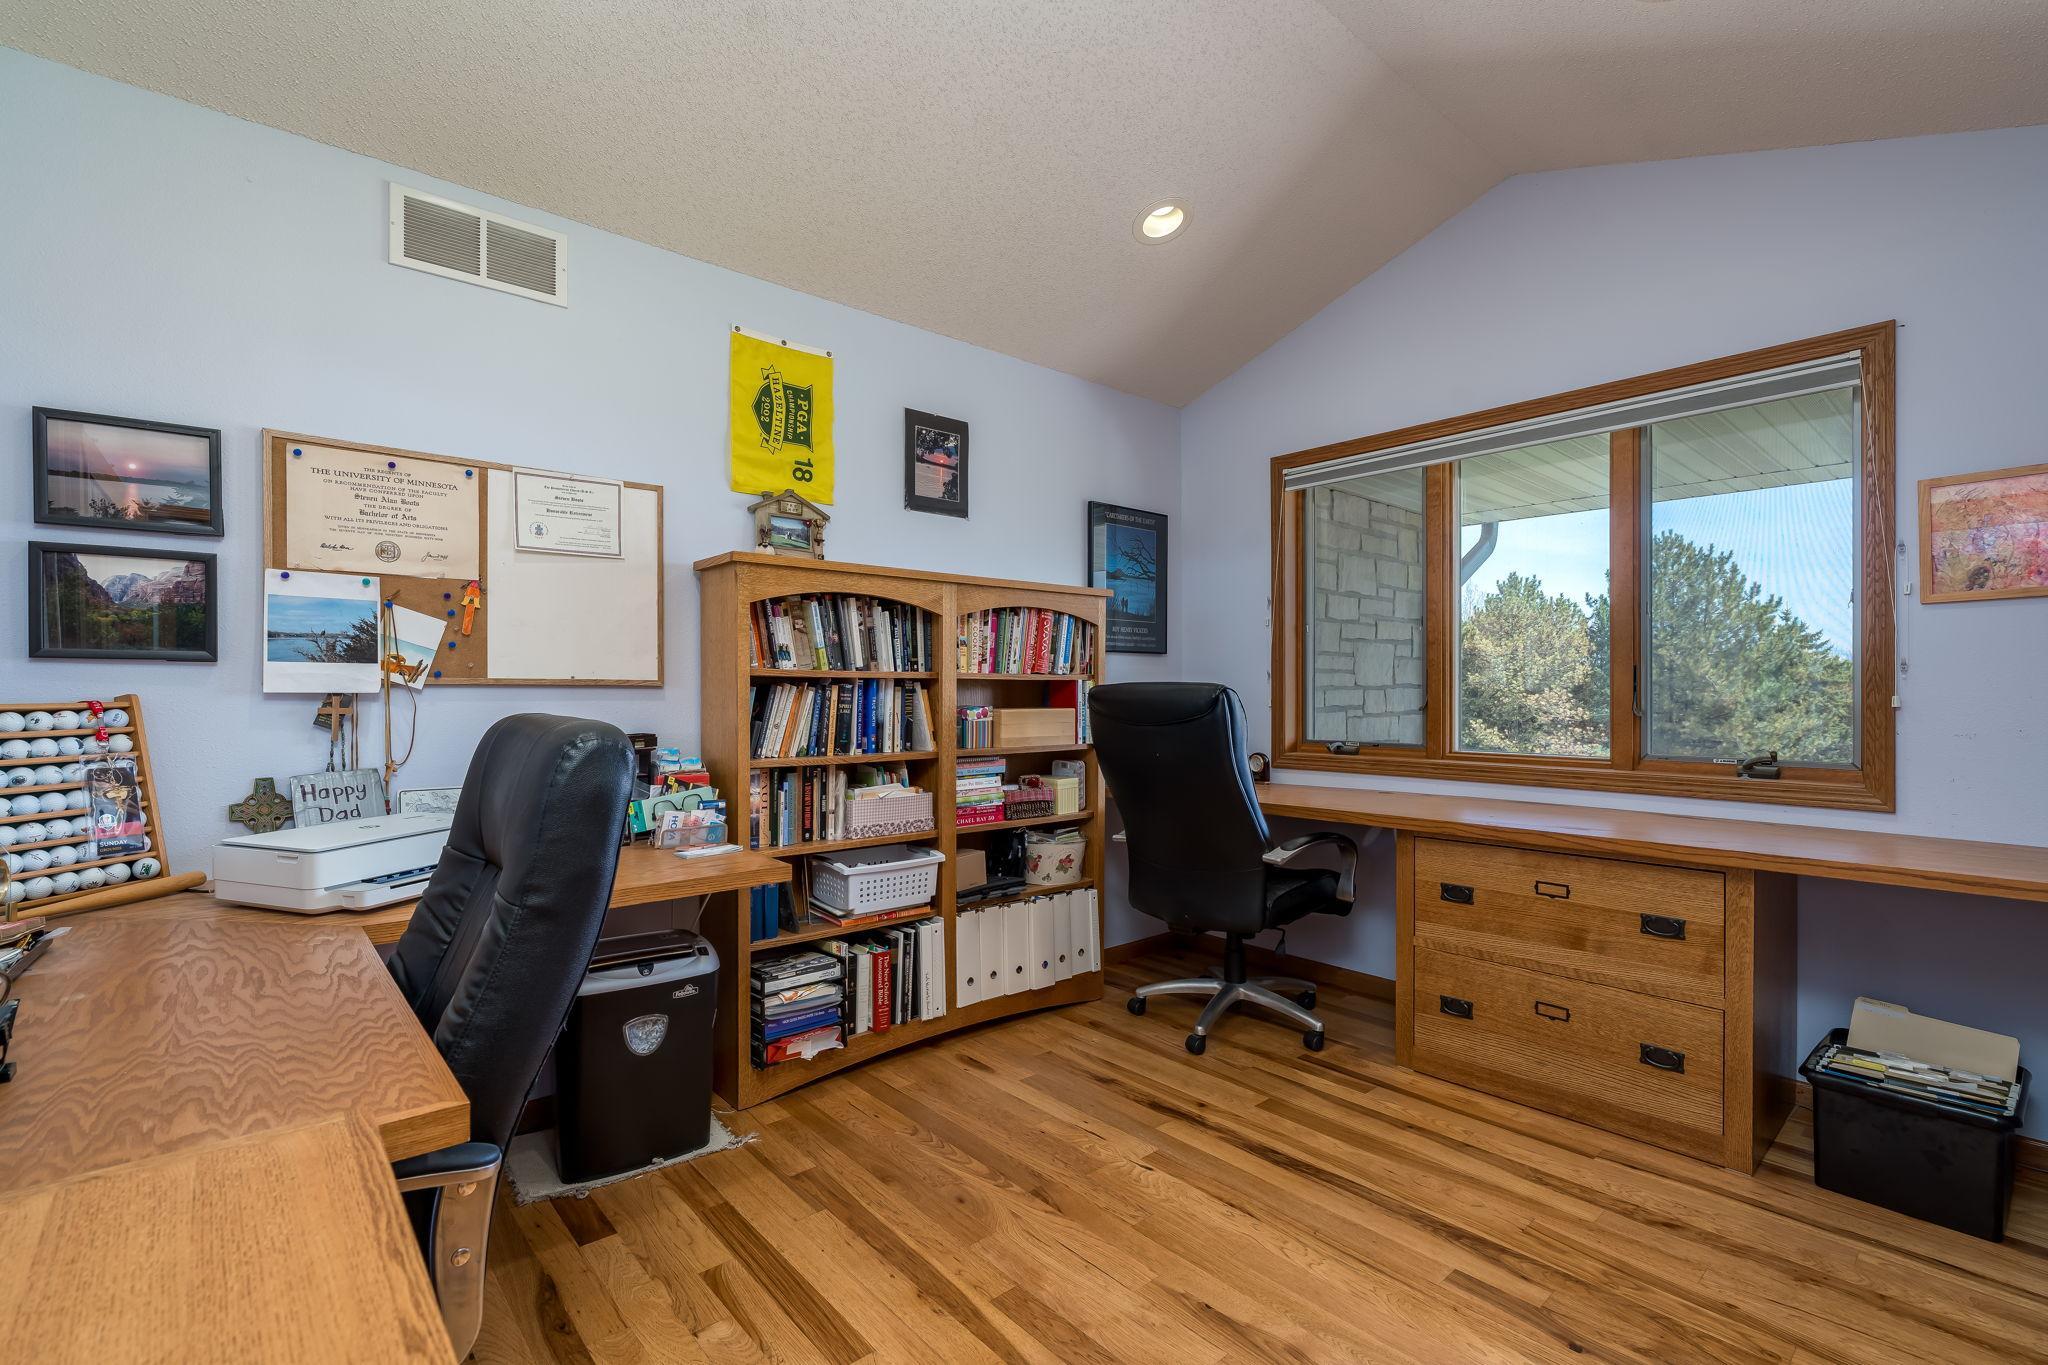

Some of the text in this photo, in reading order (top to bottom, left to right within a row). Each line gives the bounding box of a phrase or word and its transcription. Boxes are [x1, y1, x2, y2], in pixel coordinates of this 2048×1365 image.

[760, 396, 770, 422] 2002
[771, 377, 783, 445] HAZELTINE
[786, 389, 794, 440] CHAMPIONSHIP
[797, 400, 808, 434] PGA
[310, 467, 330, 476] THE
[334, 470, 391, 482] UNIVERSITY
[407, 479, 458, 491] MINNESOTA
[792, 458, 814, 483] 18
[334, 480, 396, 491] RECOMMENDATION
[369, 488, 406, 496] CONFERRED
[359, 509, 388, 518] Bachelor
[300, 782, 367, 804] Happy
[318, 804, 362, 823] Dad
[100, 839, 128, 847] SUNDAY
